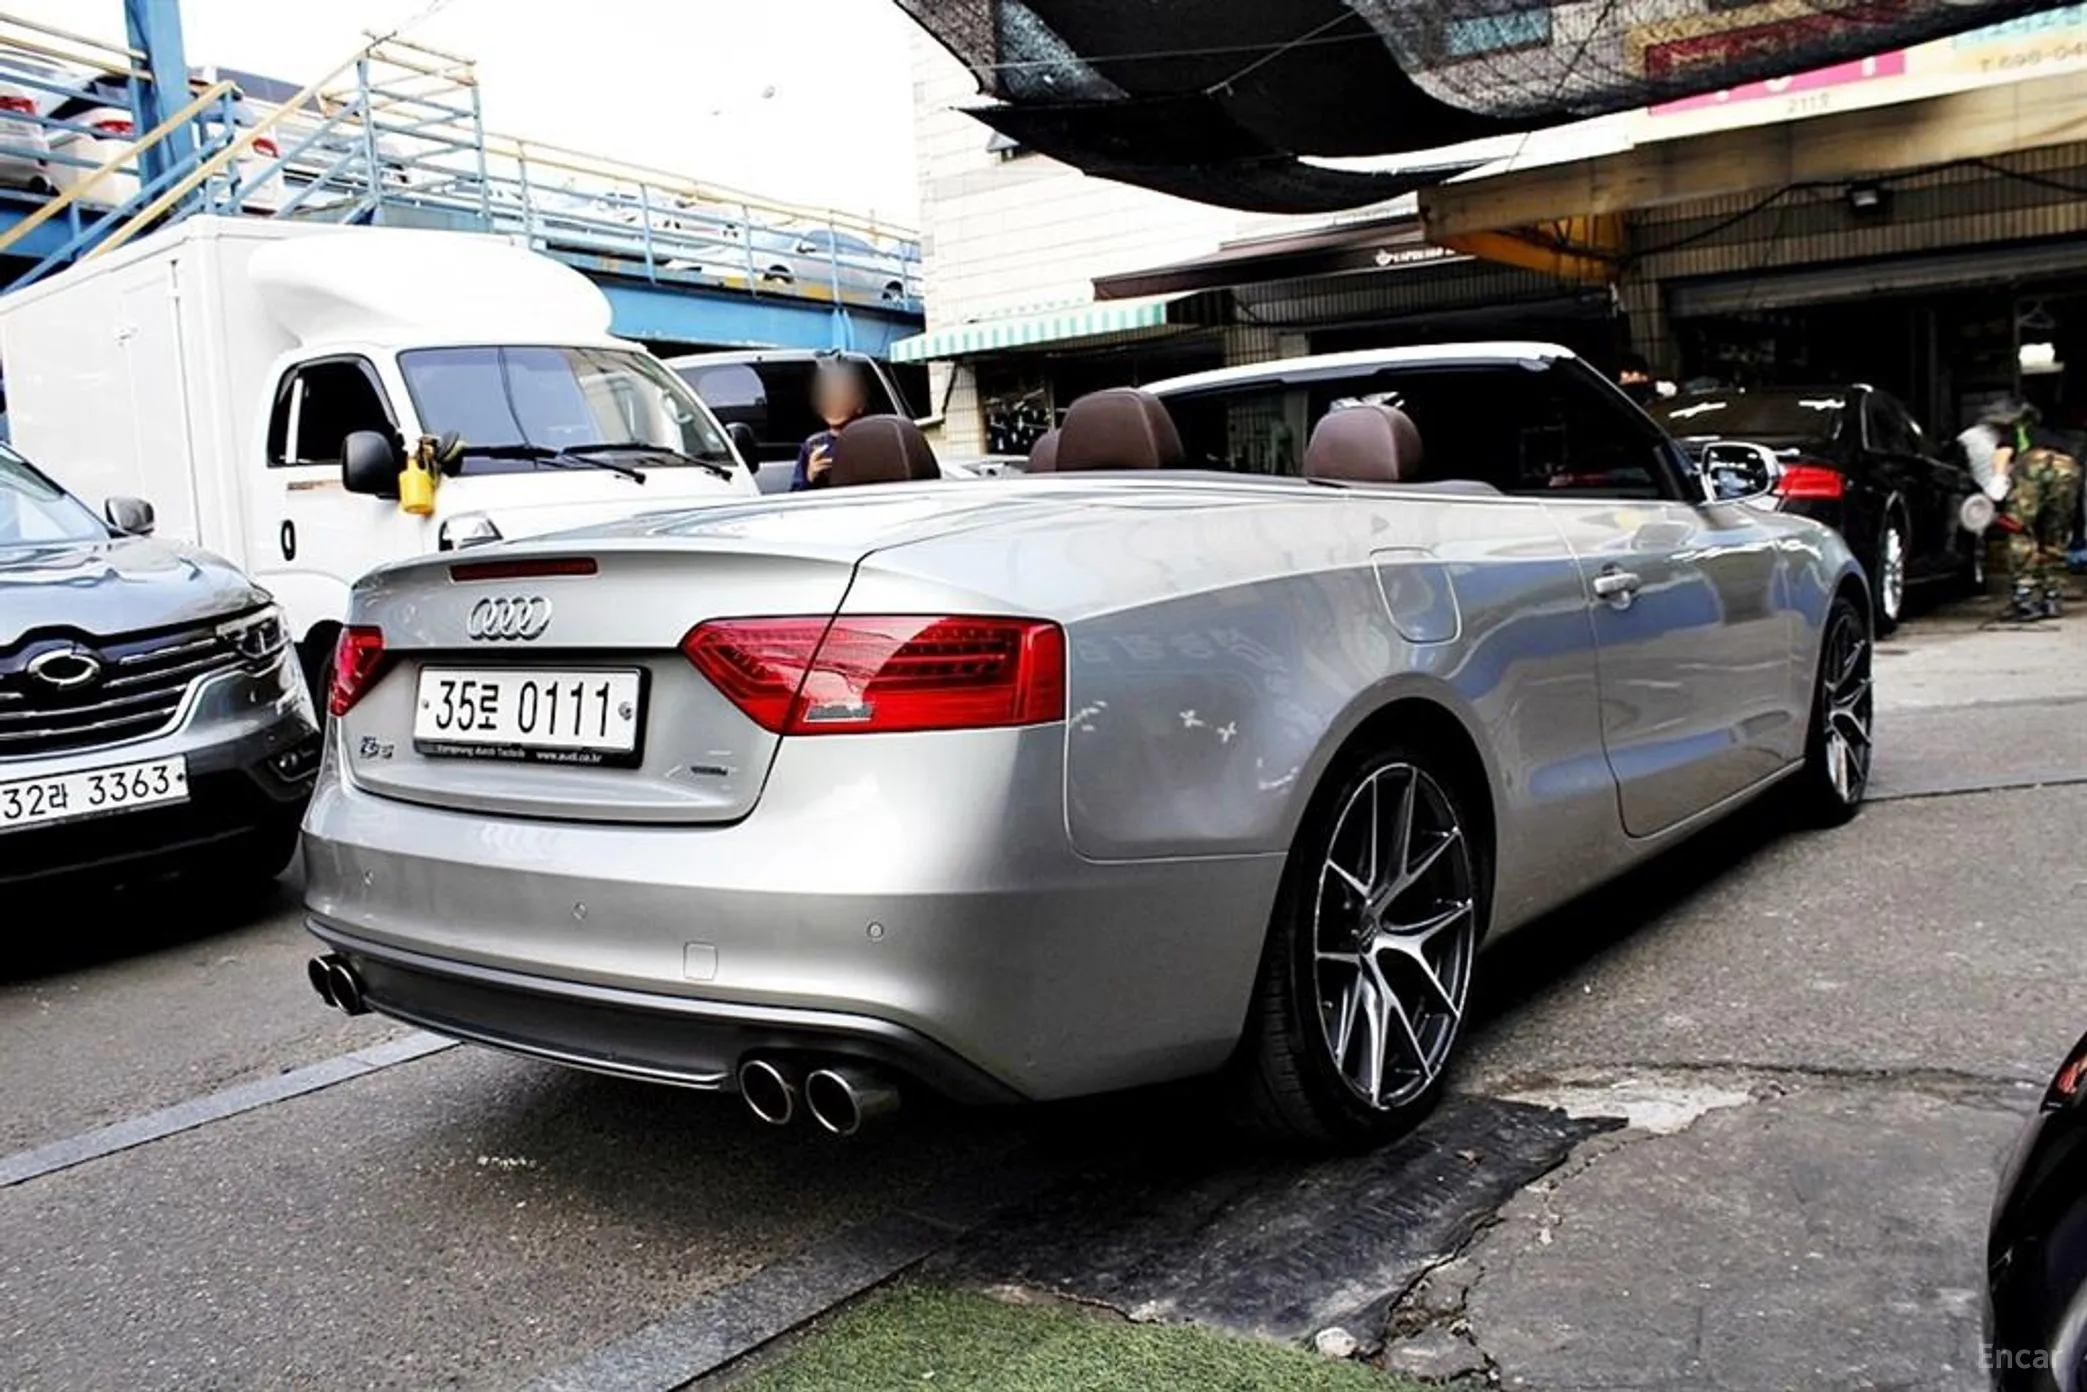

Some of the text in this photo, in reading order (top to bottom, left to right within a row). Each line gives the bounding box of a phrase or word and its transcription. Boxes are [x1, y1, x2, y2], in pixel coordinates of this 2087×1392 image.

[436, 680, 610, 737] 35로 0111
[3, 765, 169, 819] 32라 3363
